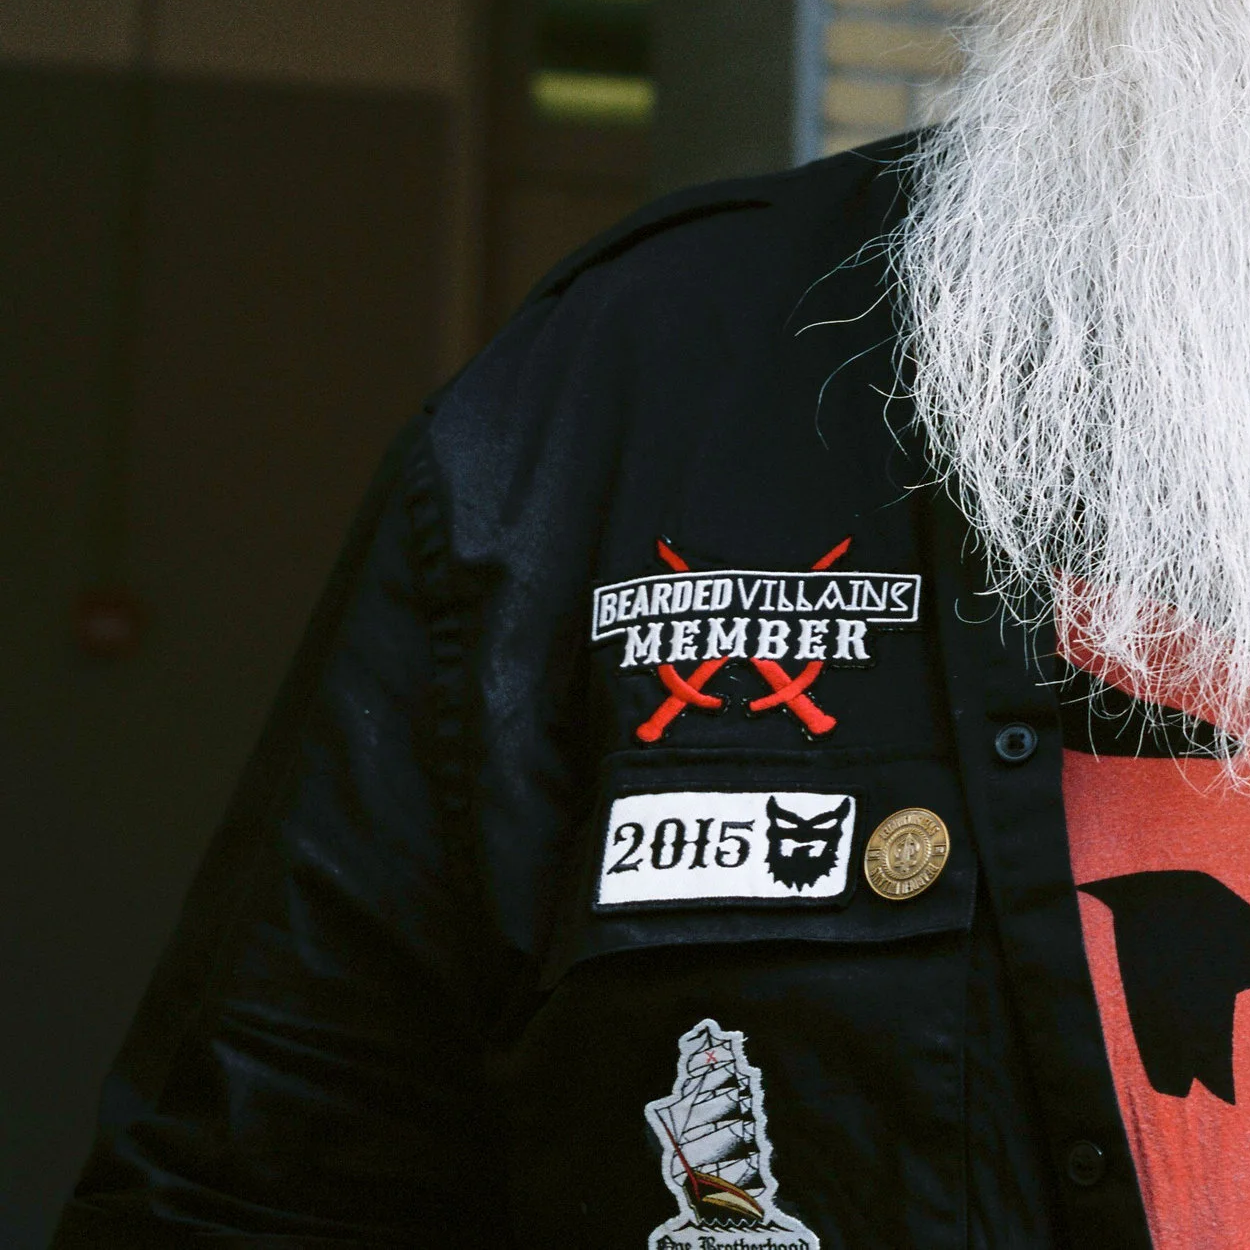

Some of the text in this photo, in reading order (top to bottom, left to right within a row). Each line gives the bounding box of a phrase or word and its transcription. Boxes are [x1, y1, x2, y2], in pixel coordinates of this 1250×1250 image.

[599, 578, 914, 624] BEARDED VILLAINS
[620, 617, 871, 668] MEMBER
[606, 817, 756, 876] 2015
